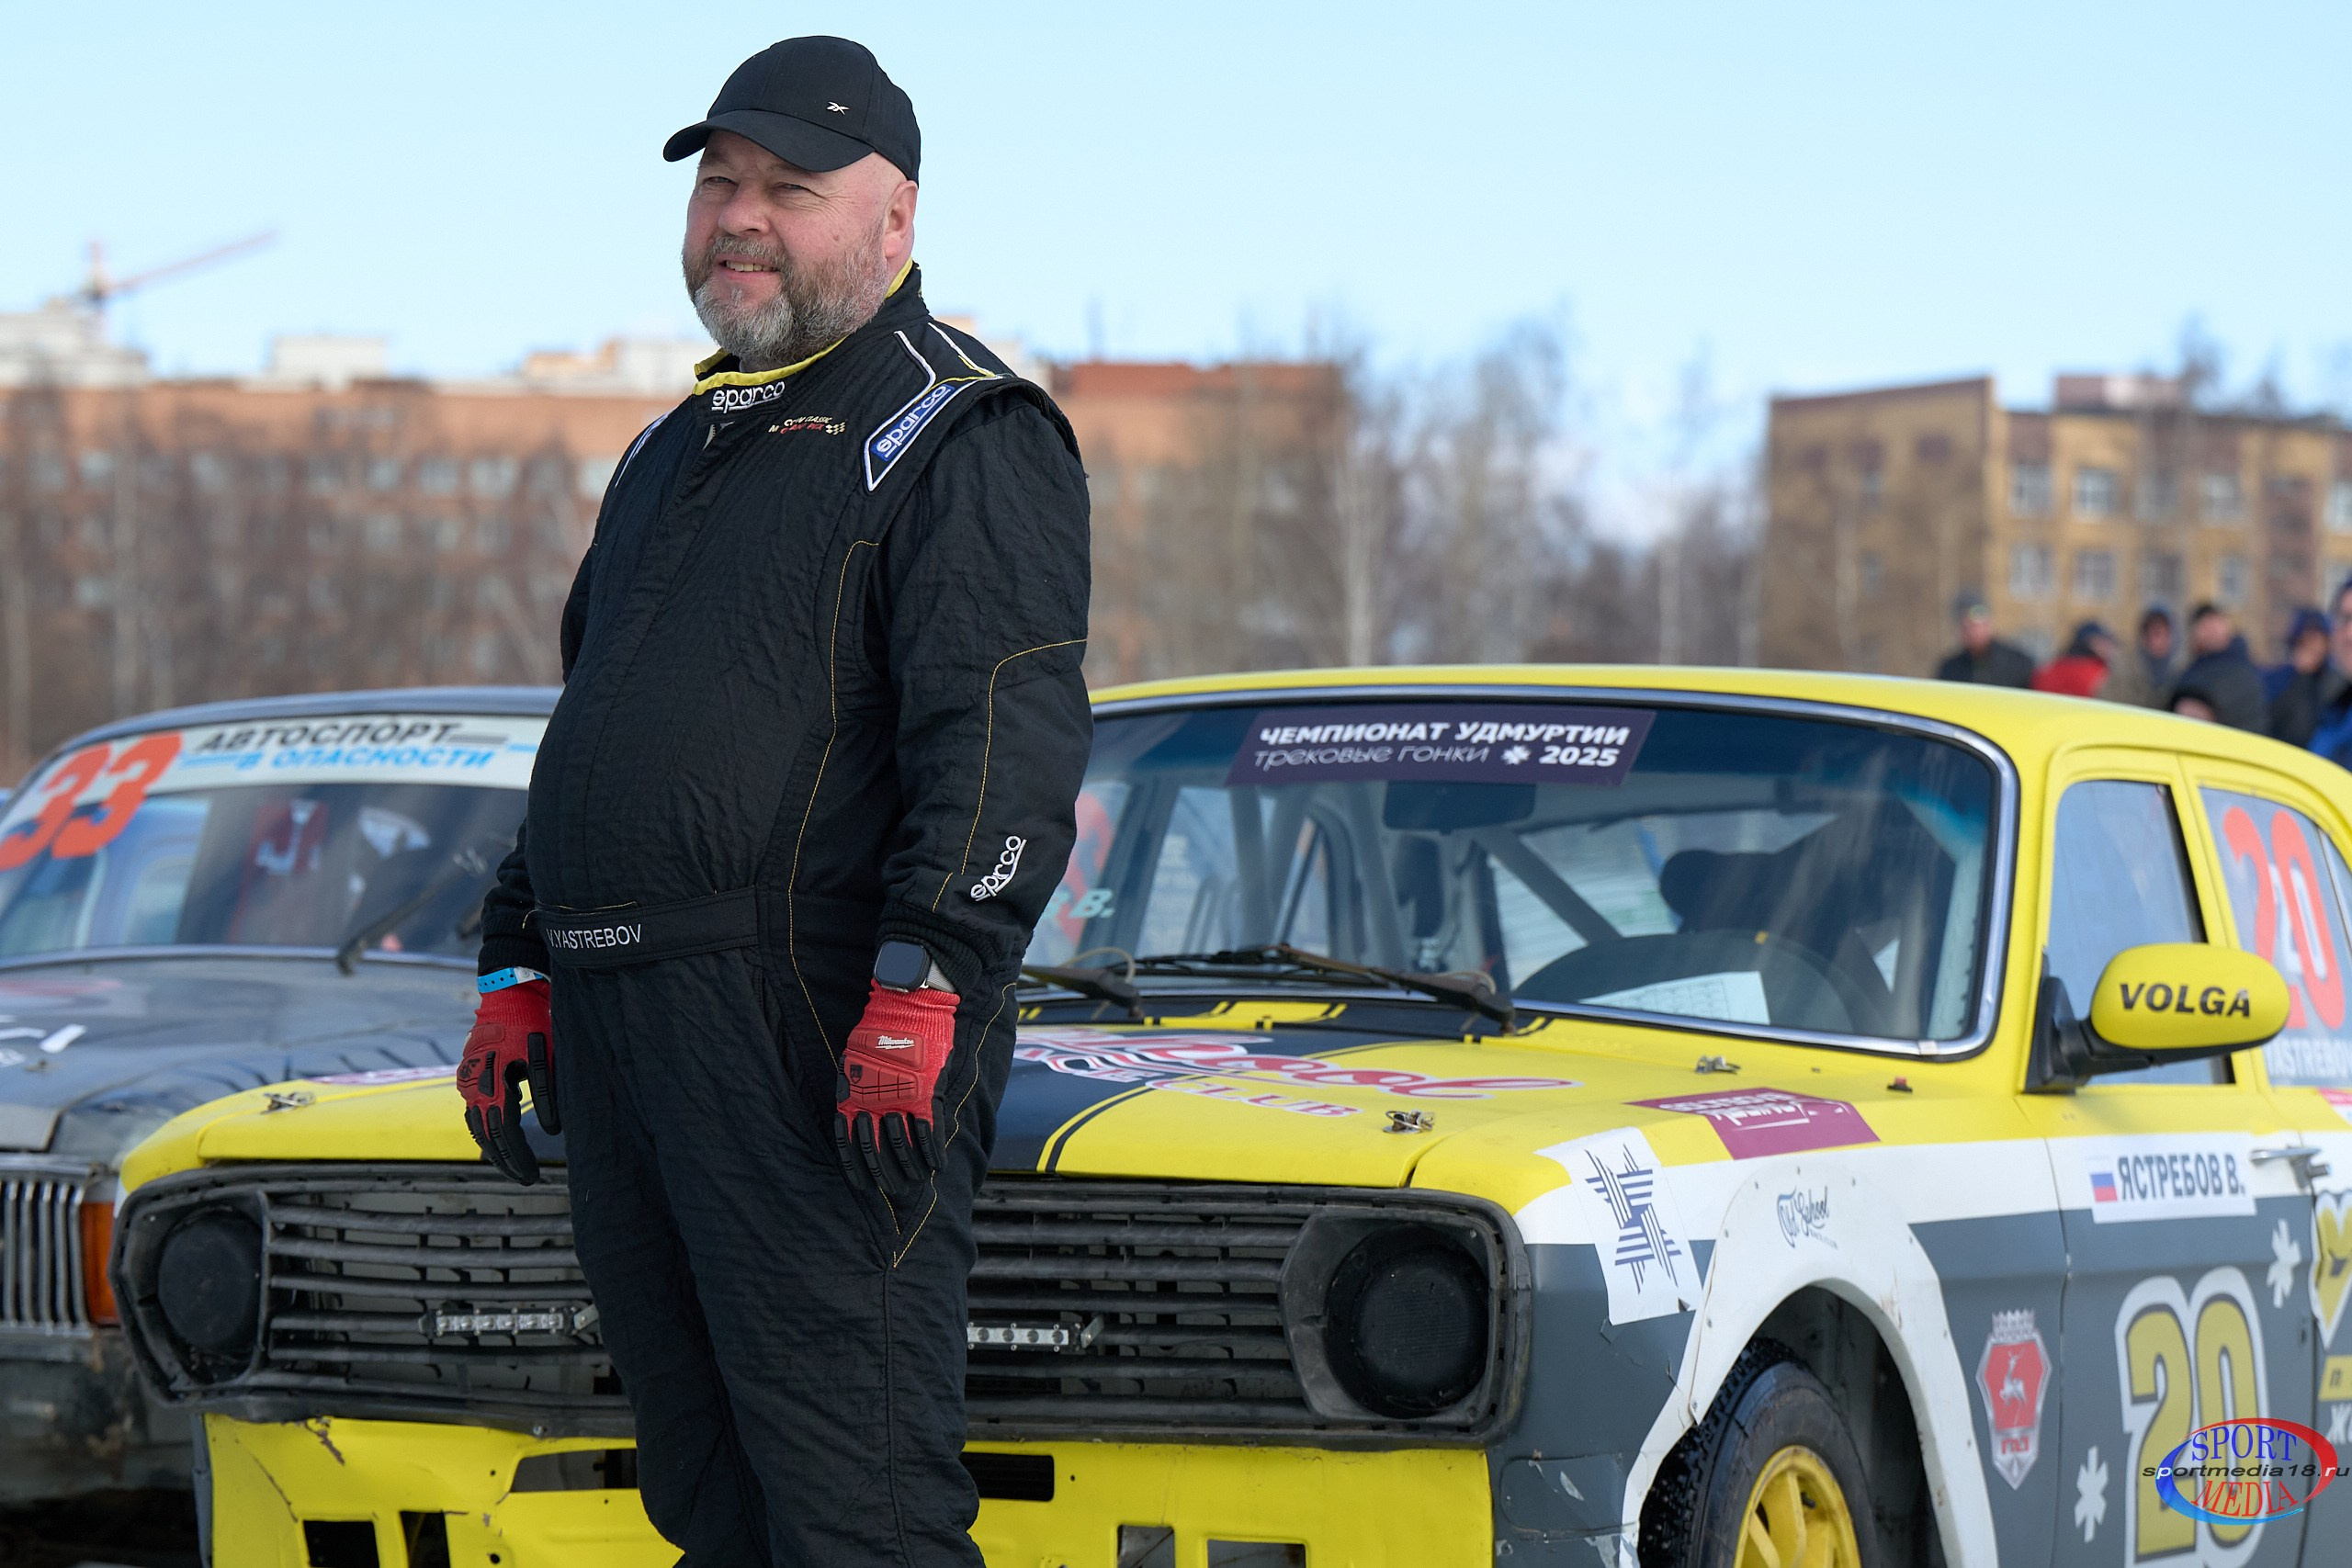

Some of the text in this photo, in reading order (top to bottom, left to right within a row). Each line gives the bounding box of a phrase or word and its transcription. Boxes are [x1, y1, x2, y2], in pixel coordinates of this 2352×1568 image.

[712, 381, 786, 413] sparco
[876, 385, 952, 458] sparco
[197, 722, 461, 753] АВТОСПОРТ
[1260, 721, 1631, 745] ЧЕМПИОНАТ УДМУРТИИ
[271, 747, 495, 768] ОПАСНОСТИ
[1539, 746, 1620, 767] 2025
[0, 730, 183, 871] 33
[2222, 806, 2346, 1030] 20
[2120, 983, 2251, 1019] VOLGA
[1145, 1077, 1363, 1117] CLUB
[2118, 1153, 2223, 1201] ЯСТРЕБОВ
[2120, 1281, 2267, 1564] 20
